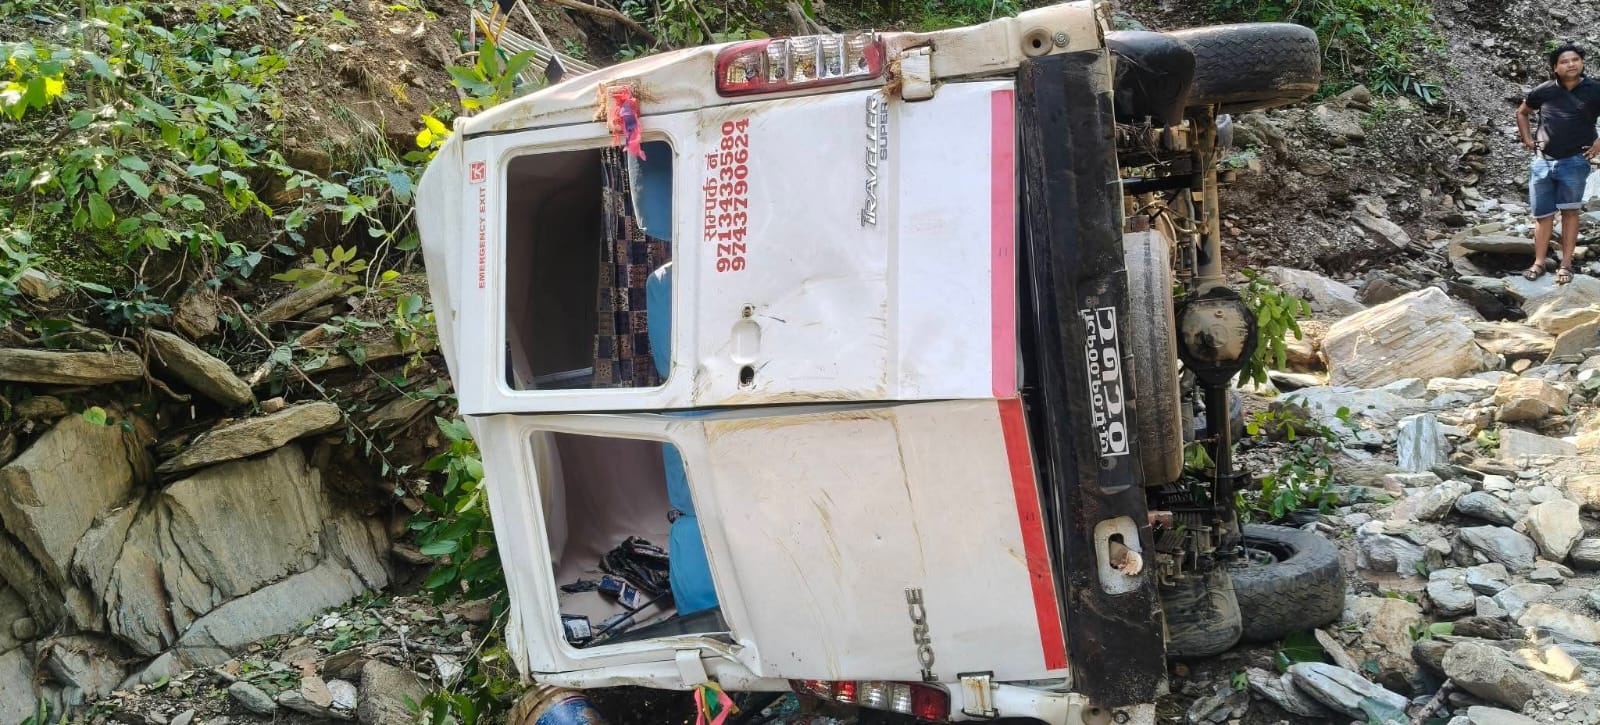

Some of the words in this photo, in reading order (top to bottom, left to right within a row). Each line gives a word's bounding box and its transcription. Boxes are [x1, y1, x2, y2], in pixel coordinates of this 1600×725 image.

[861, 95, 878, 227] TRAVELLER
[880, 102, 888, 161] SUPER
[703, 177, 718, 242] सम्पर्क
[716, 120, 735, 273] 9713433580
[731, 118, 749, 272] 9743790624
[905, 587, 939, 682] FORCE
